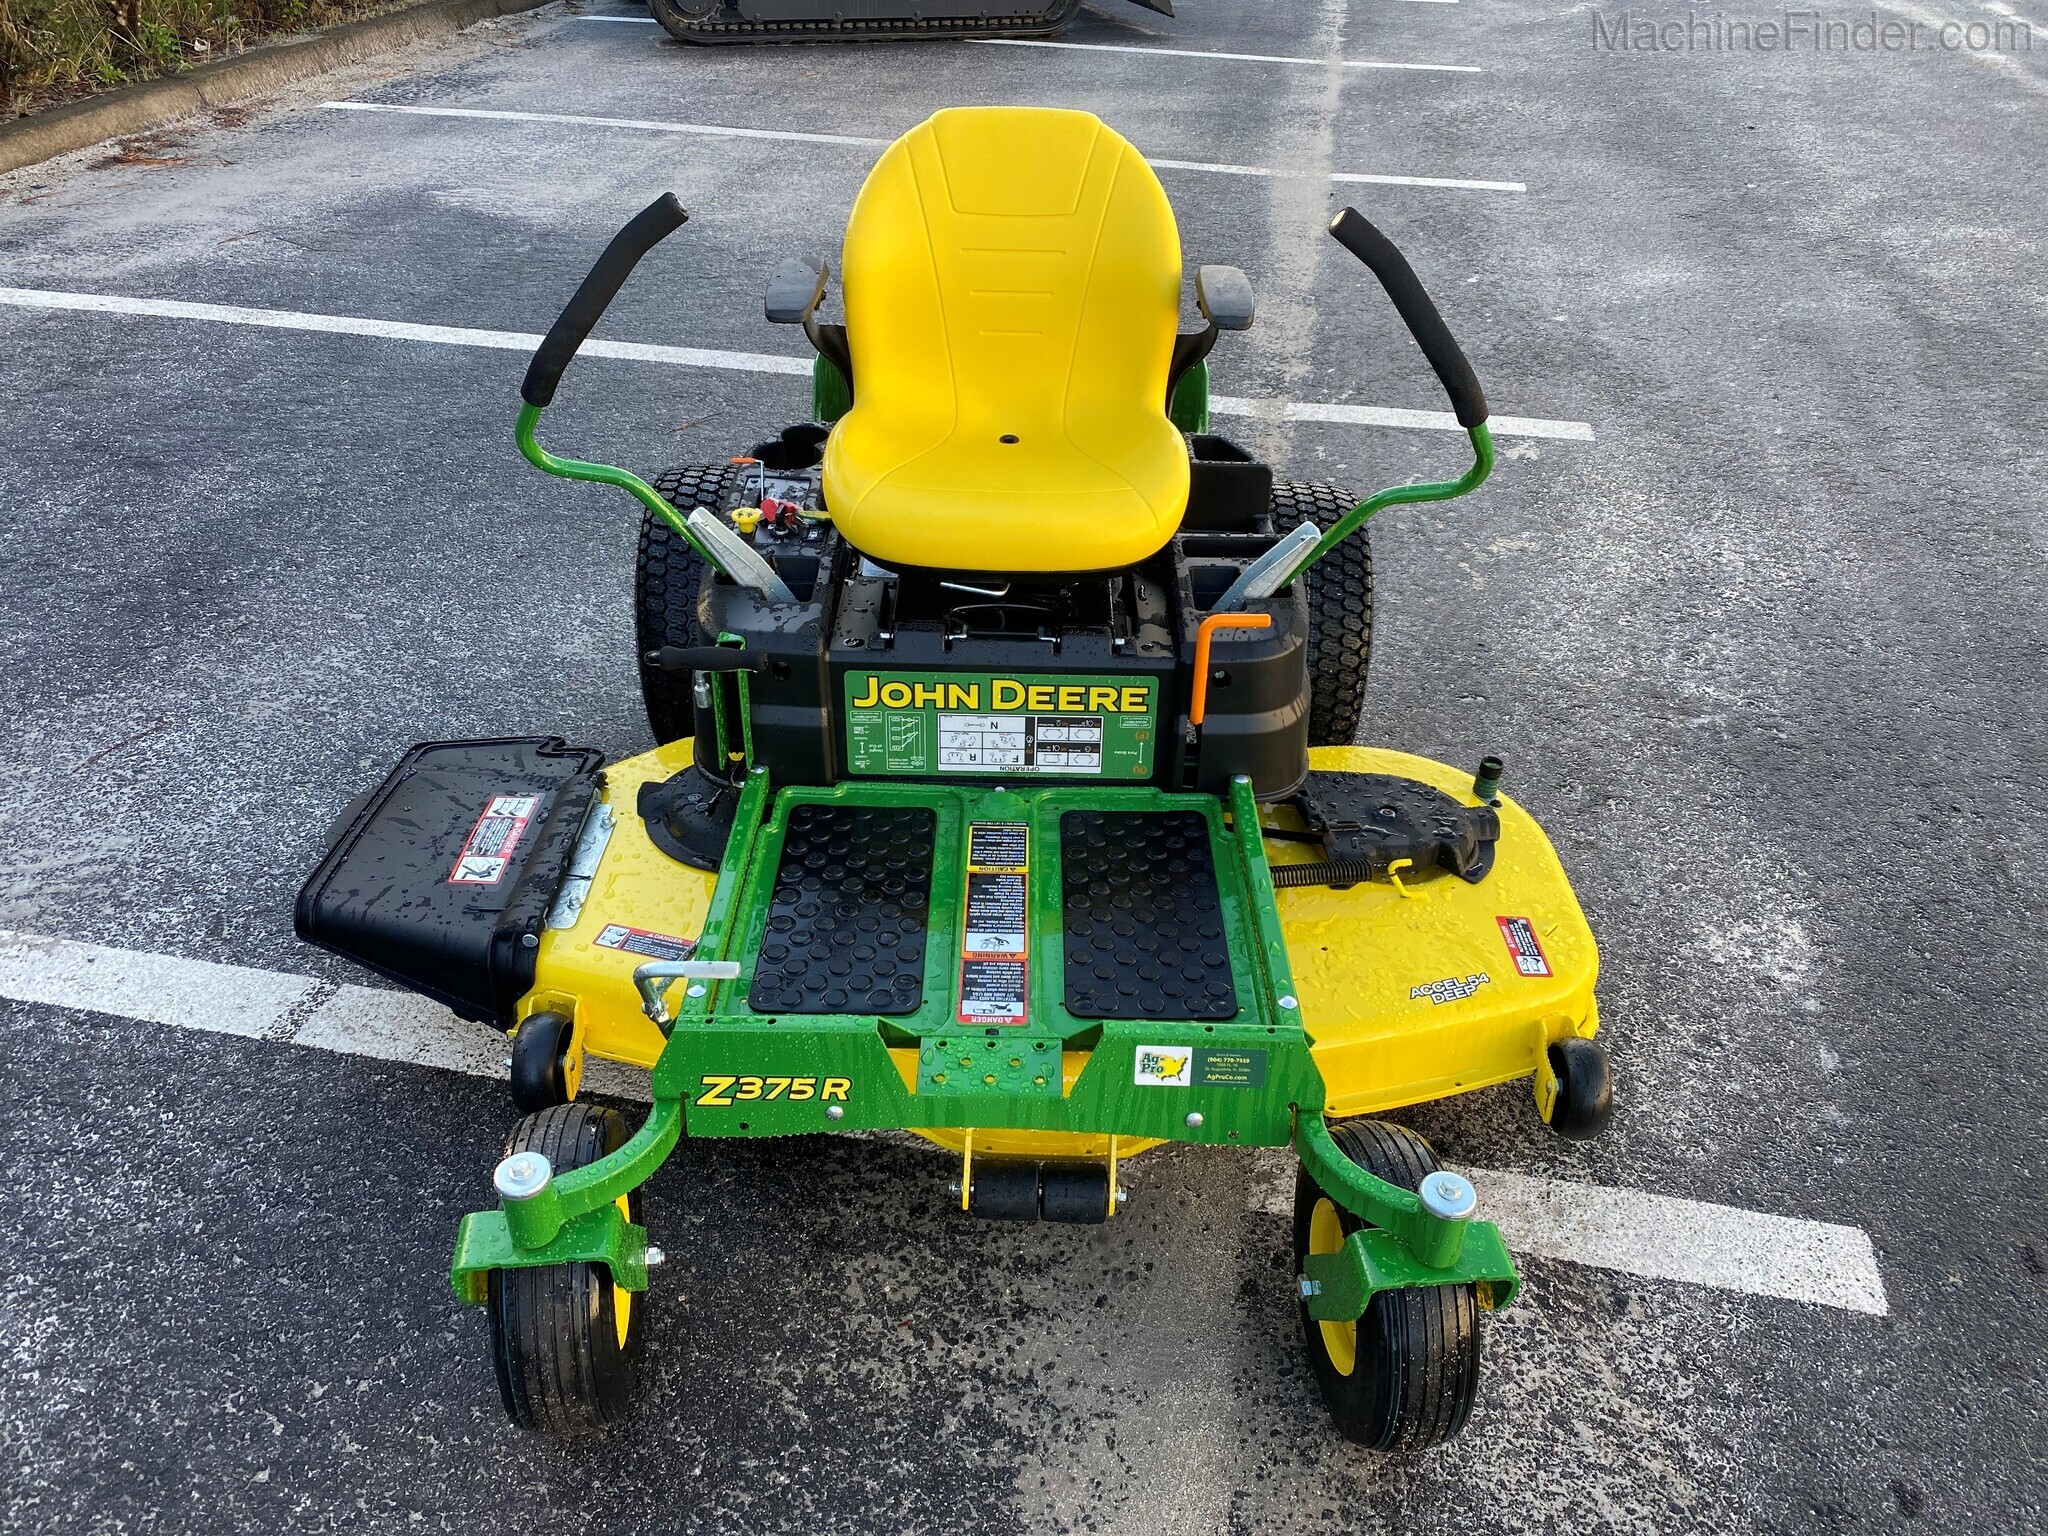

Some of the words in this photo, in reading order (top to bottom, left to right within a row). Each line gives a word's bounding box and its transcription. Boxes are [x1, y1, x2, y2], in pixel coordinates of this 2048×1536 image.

[853, 676, 980, 711] JOHN
[990, 678, 1150, 713] DEERE
[990, 722, 998, 730] N
[969, 753, 976, 761] R
[1012, 755, 1019, 763] F
[502, 827, 521, 854] DANGER
[653, 934, 684, 944] DANGER
[1410, 977, 1466, 1000] ACCEL
[1466, 972, 1491, 987] 54
[1430, 985, 1477, 1005] DEEP
[971, 1015, 1003, 1023] DANGER
[1140, 1063, 1165, 1075] Pro
